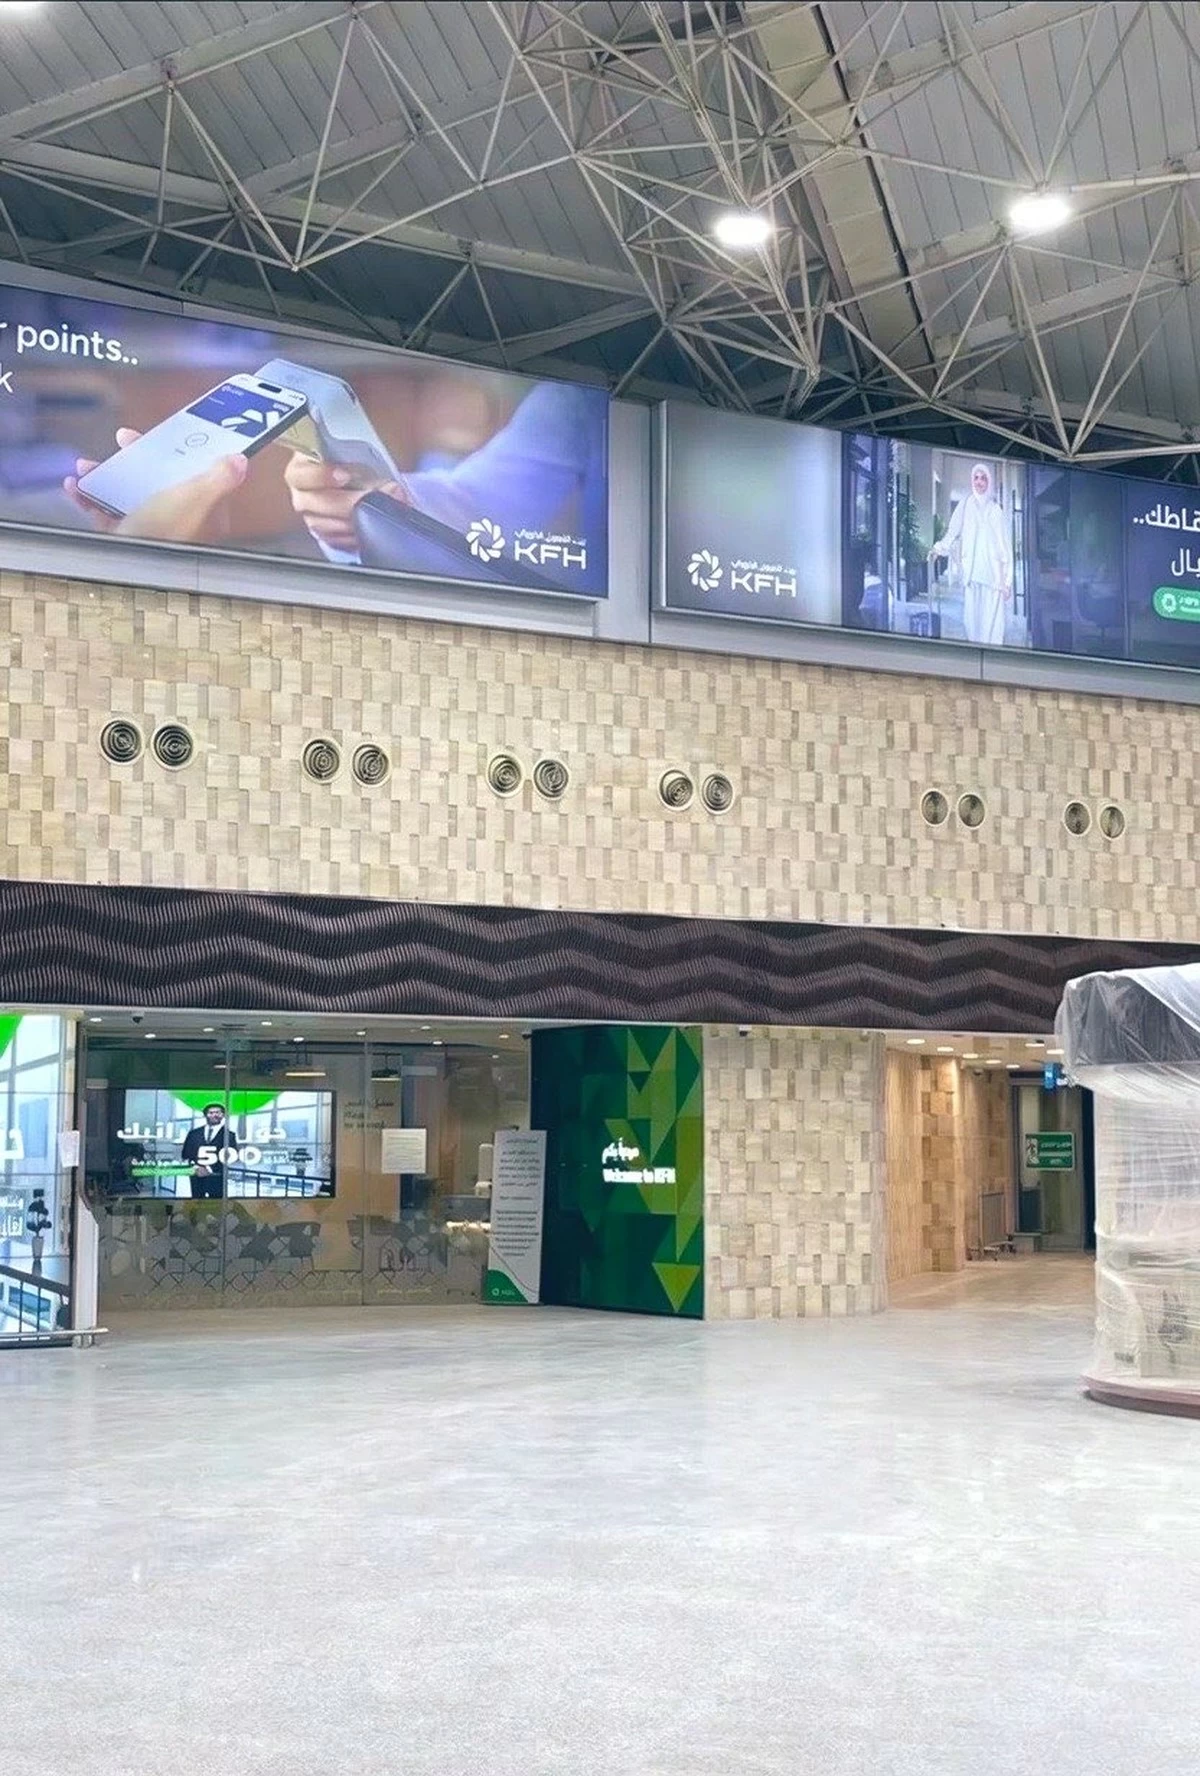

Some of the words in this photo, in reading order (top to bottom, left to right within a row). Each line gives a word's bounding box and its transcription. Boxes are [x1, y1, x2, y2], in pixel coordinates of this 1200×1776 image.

[17, 323, 138, 365] points..
[514, 540, 586, 569] KFH
[731, 570, 796, 597] KFH
[197, 1145, 262, 1166] 500
